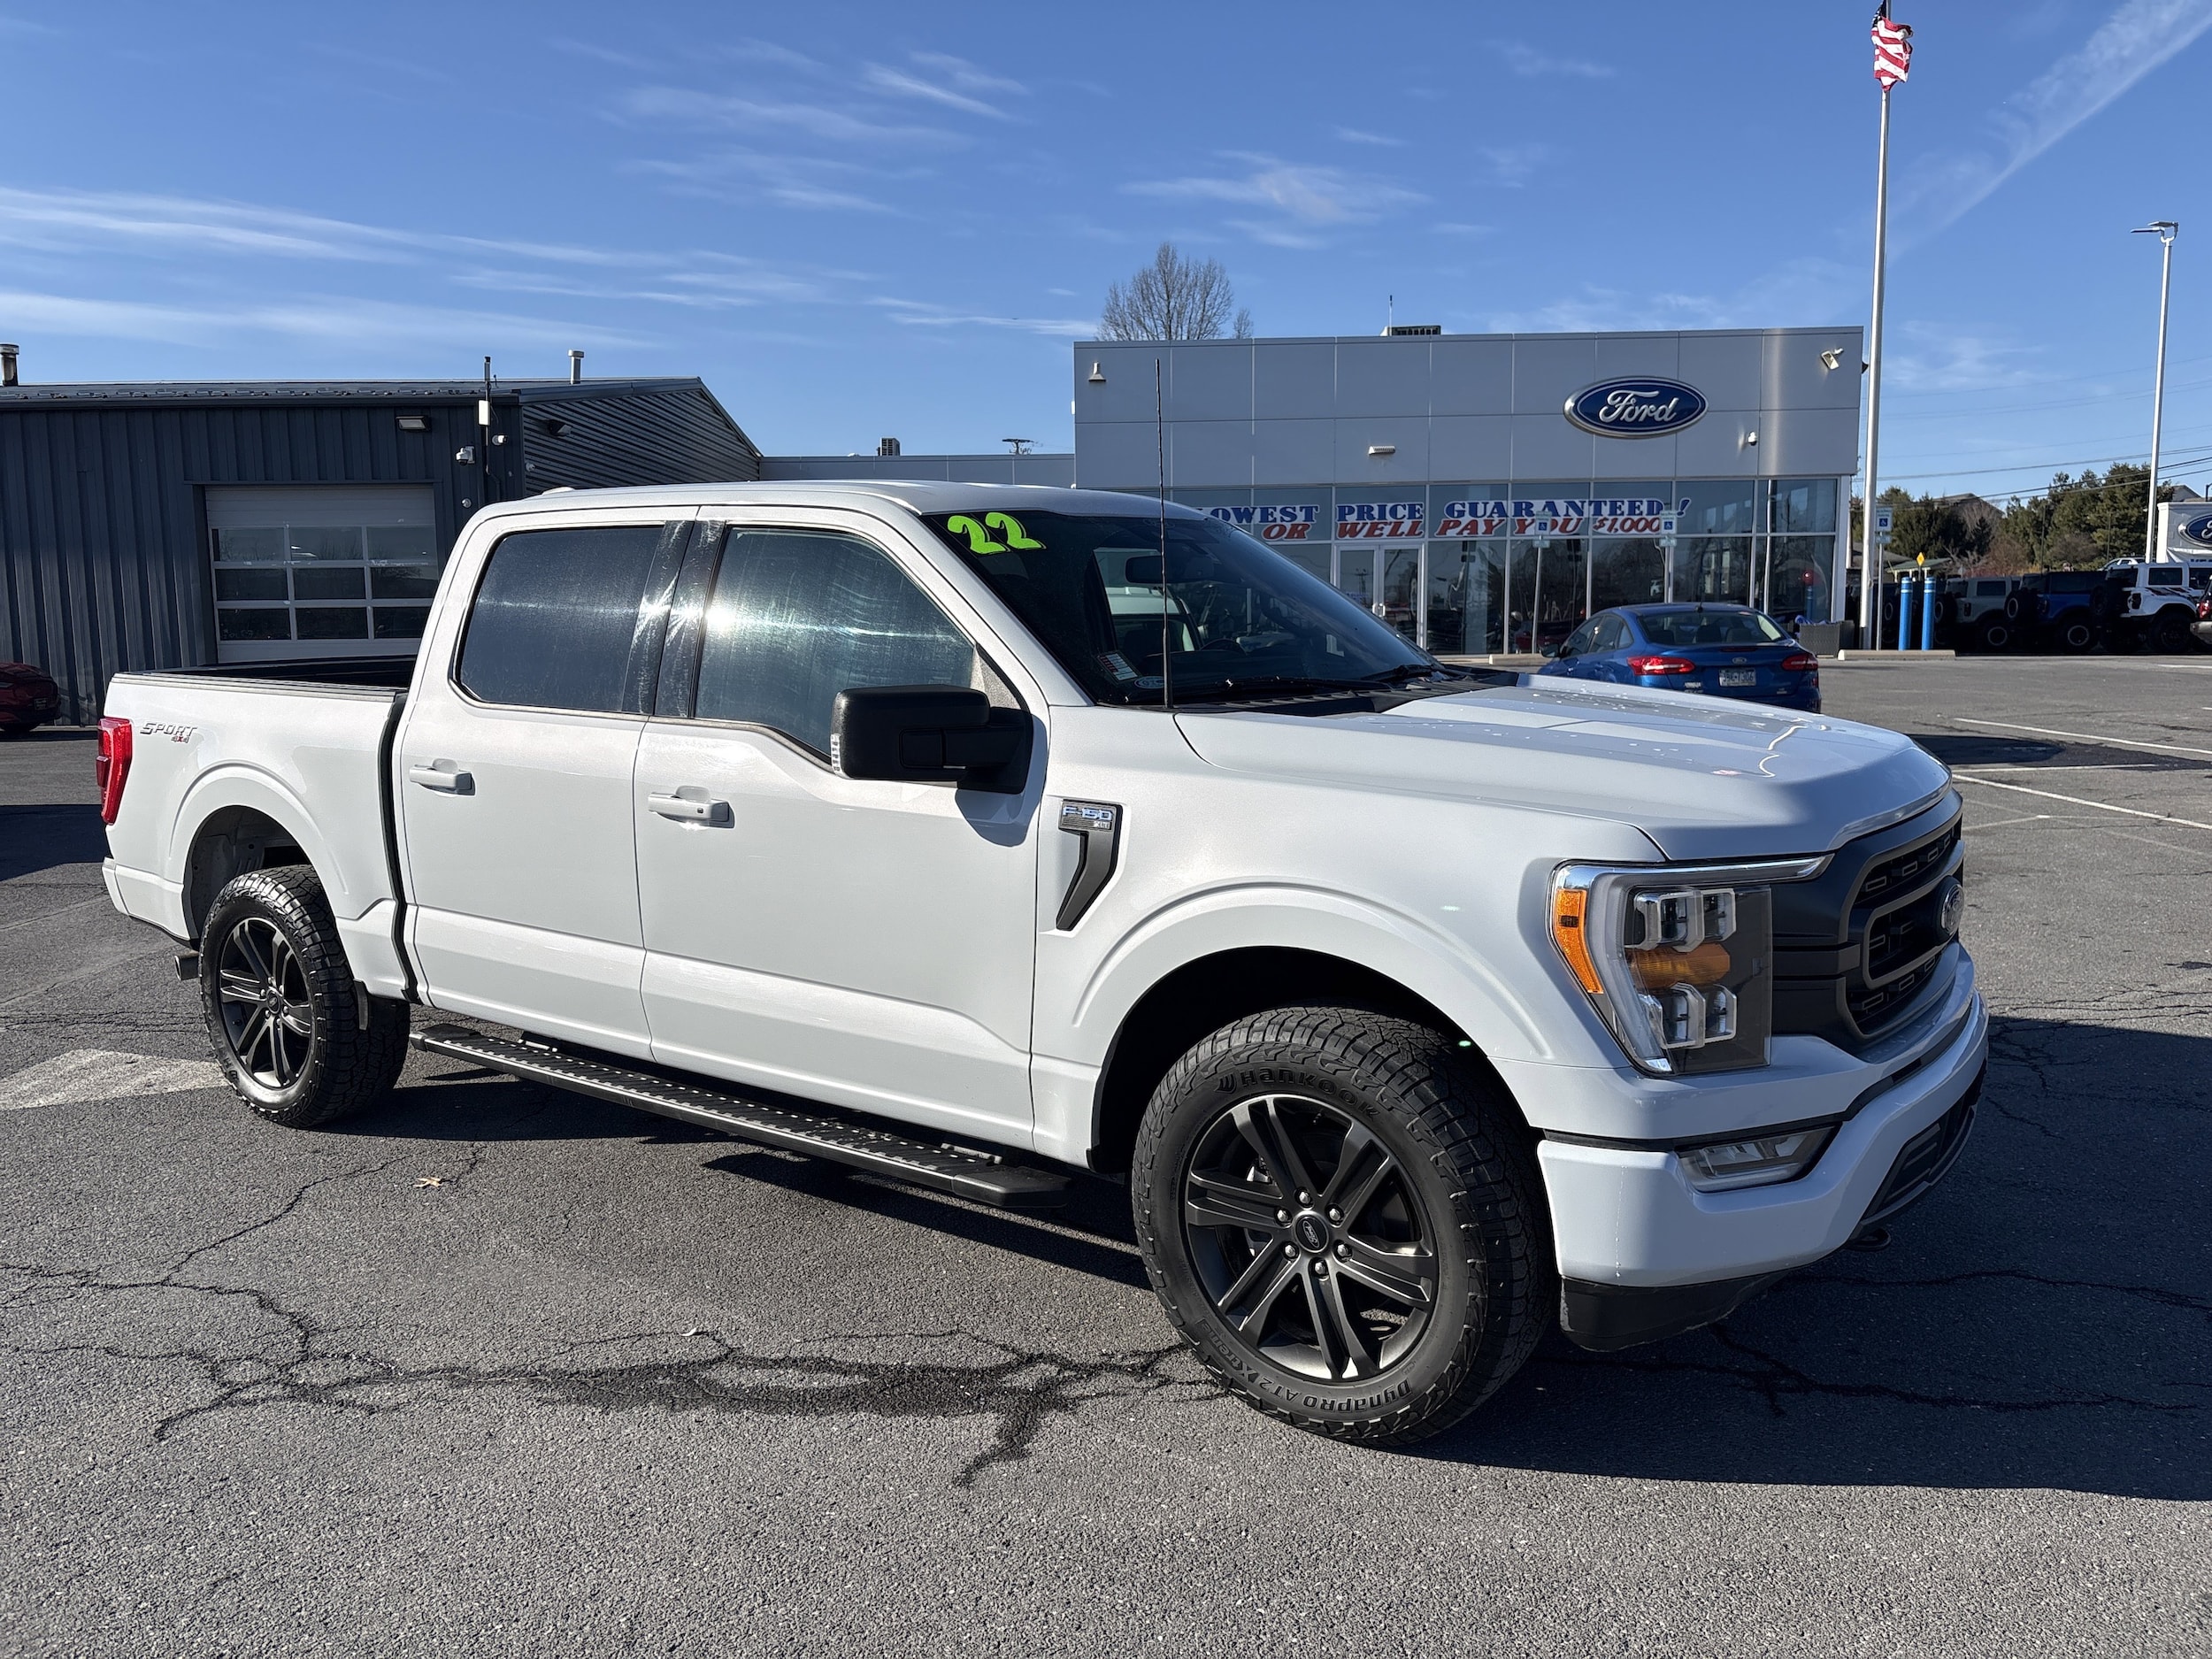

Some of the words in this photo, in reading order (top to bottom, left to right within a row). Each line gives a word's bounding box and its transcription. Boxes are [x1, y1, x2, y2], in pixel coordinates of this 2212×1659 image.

[1599, 389, 1679, 423] Ford
[1197, 505, 1318, 524] OWEST
[1337, 503, 1424, 522] PRICE
[948, 512, 1047, 555] 22
[1263, 524, 1310, 540] OR
[1436, 519, 1505, 536] PAY
[1514, 518, 1583, 534] YU
[140, 723, 197, 736] SPORT
[1063, 806, 1113, 821] F-150
